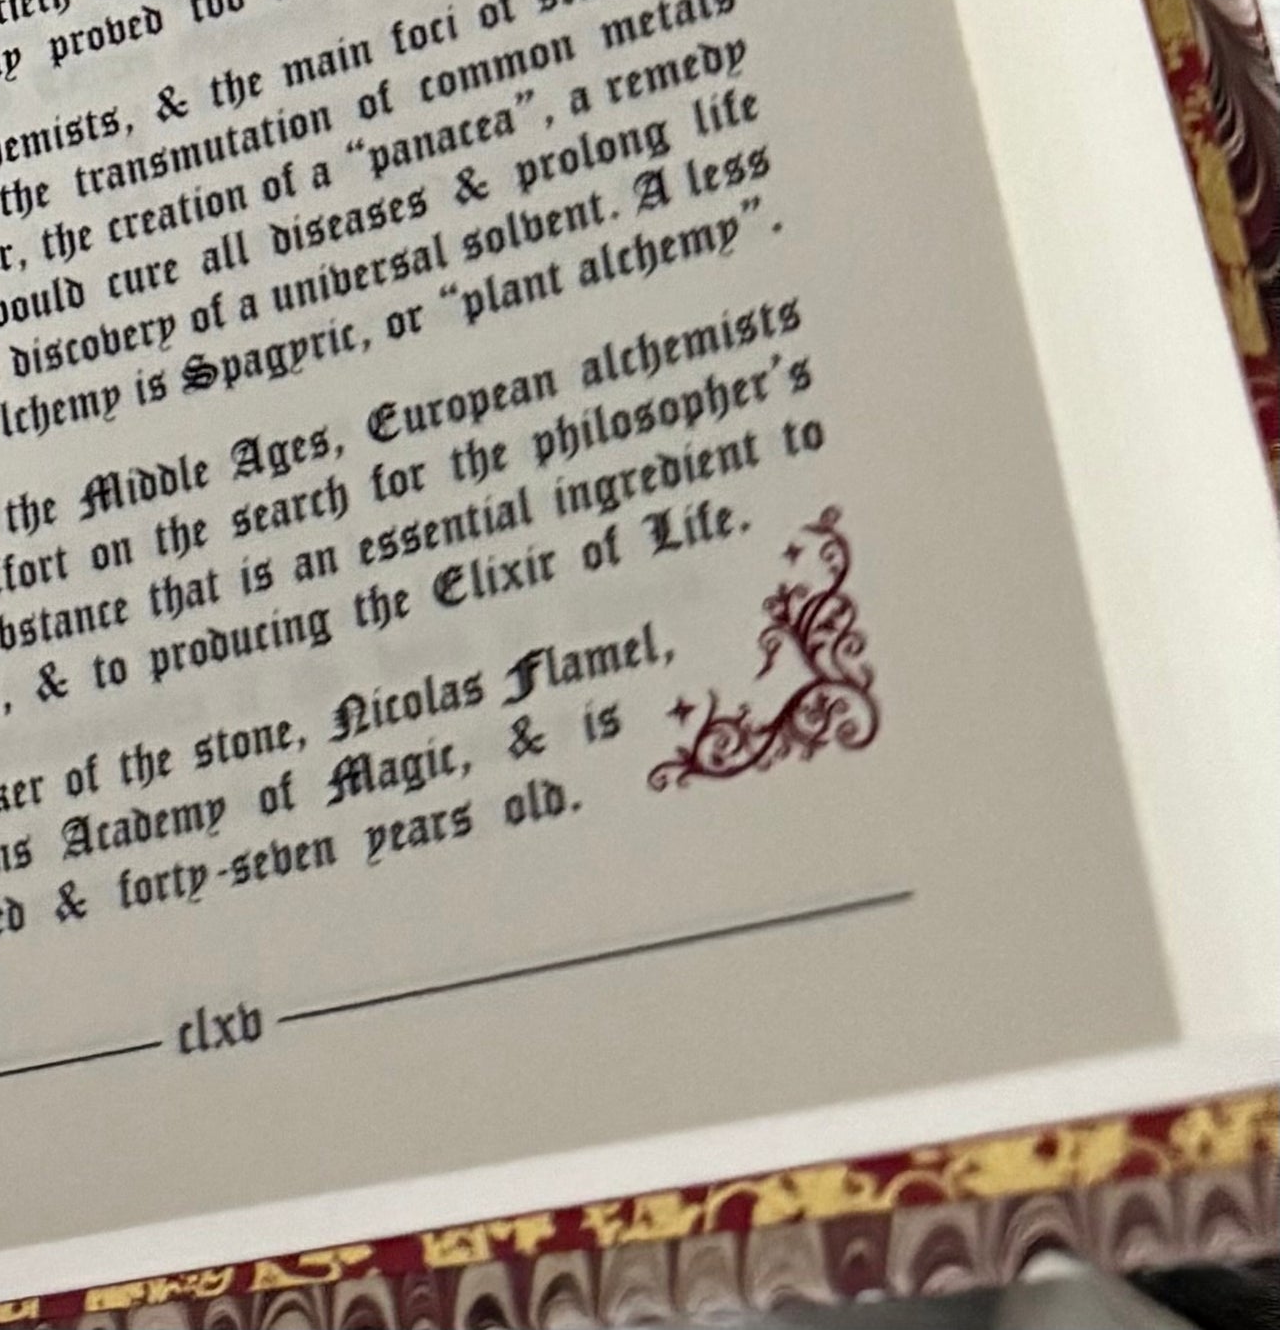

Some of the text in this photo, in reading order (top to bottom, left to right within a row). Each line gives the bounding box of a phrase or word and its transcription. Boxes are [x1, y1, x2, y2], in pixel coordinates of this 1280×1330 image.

[156, 84, 189, 124] &
[209, 69, 263, 110] the
[281, 36, 374, 89] main
[390, 3, 460, 57] foci
[135, 368, 168, 407] is
[180, 323, 372, 395] Spagyric,
[385, 304, 424, 341] or
[90, 537, 134, 572] on
[154, 514, 208, 560] the
[231, 474, 350, 539] search
[369, 462, 426, 503] for
[449, 438, 508, 485] the
[148, 568, 221, 621] that
[240, 558, 275, 596] is
[294, 546, 339, 583] an
[358, 485, 534, 567] essential
[554, 431, 760, 517] ingredient
[782, 419, 825, 457] to
[65, 752, 100, 799] of
[119, 742, 172, 790] the
[194, 720, 307, 770] stone,
[328, 670, 485, 743] Nicolas
[501, 621, 675, 707] Flamel,
[177, 1001, 263, 1056] clxv
